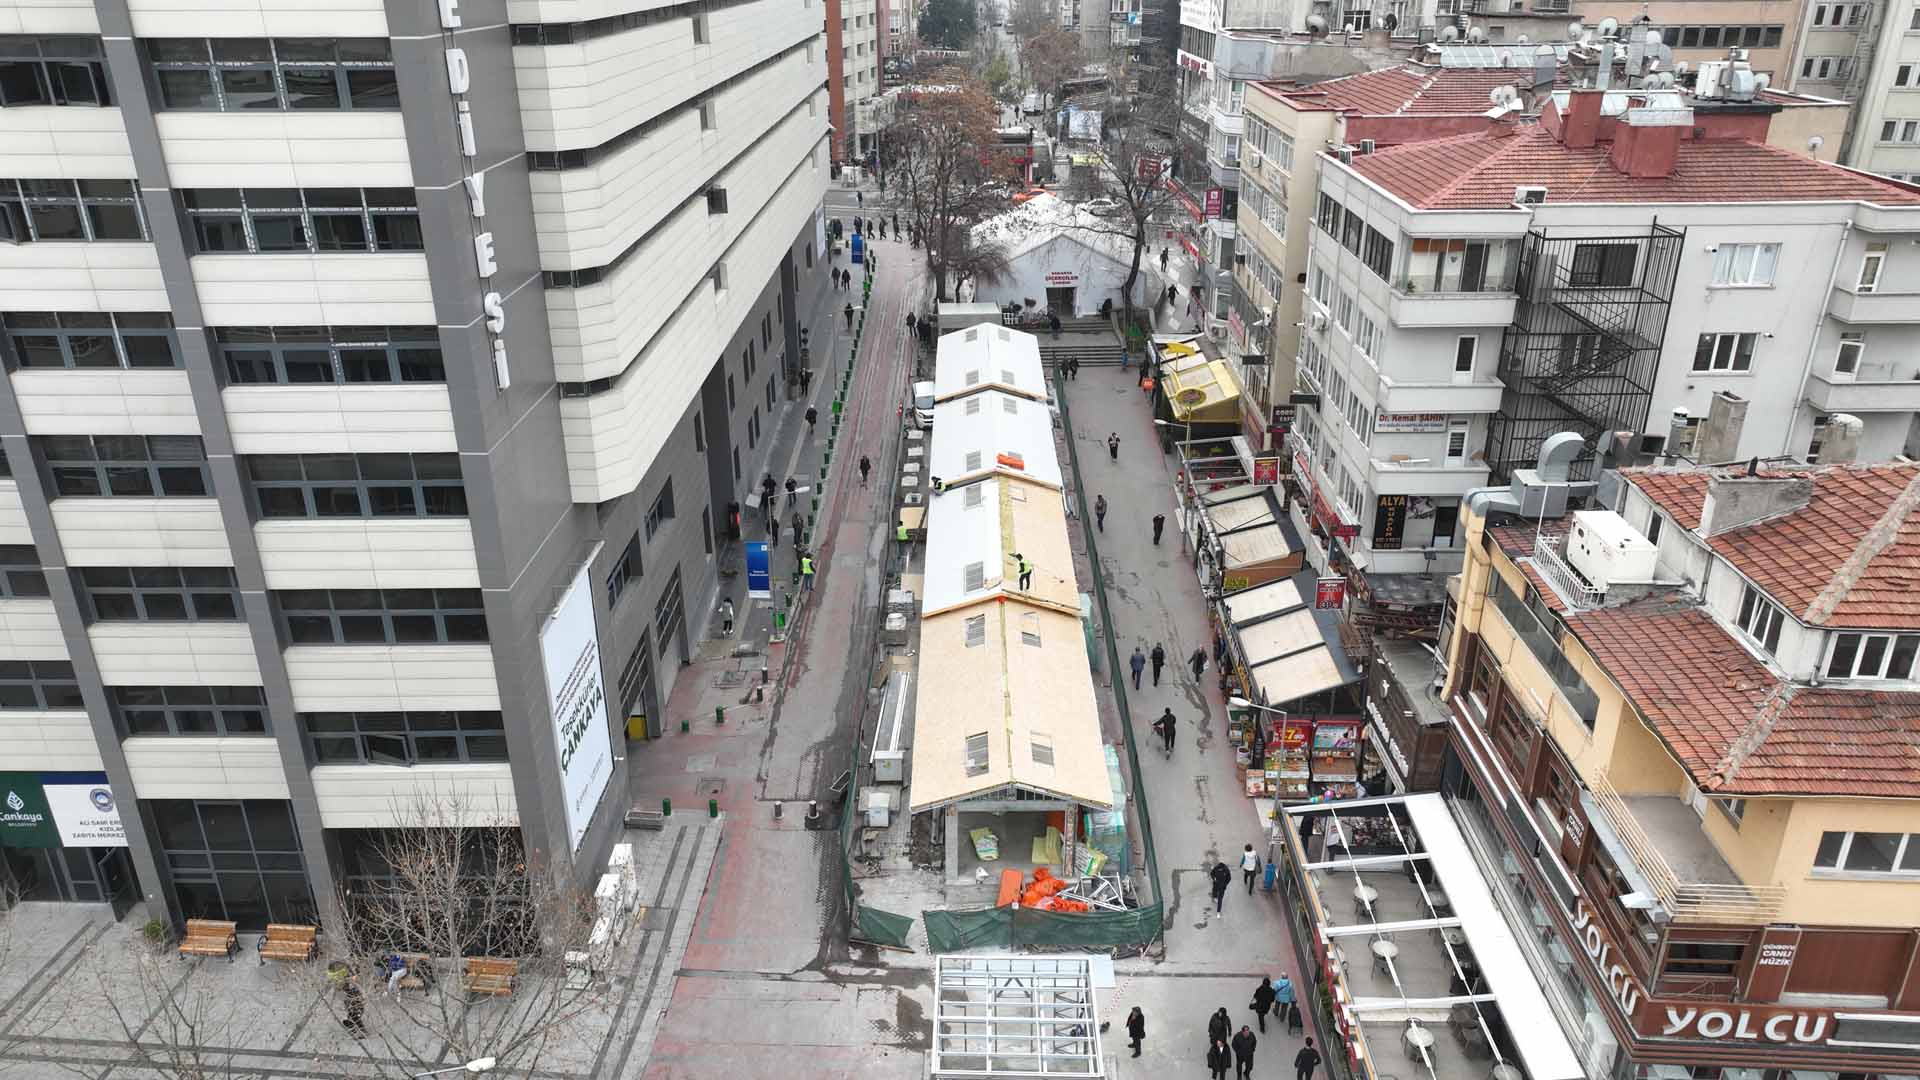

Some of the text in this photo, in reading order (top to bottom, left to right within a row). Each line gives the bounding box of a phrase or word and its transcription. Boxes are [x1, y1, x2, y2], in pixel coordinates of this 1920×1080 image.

[1380, 496, 1406, 506] ALYA
[561, 685, 603, 776] ÇANKAYA
[1573, 898, 1641, 1017] YOLCU
[1662, 1006, 1828, 1043] YOLCU
